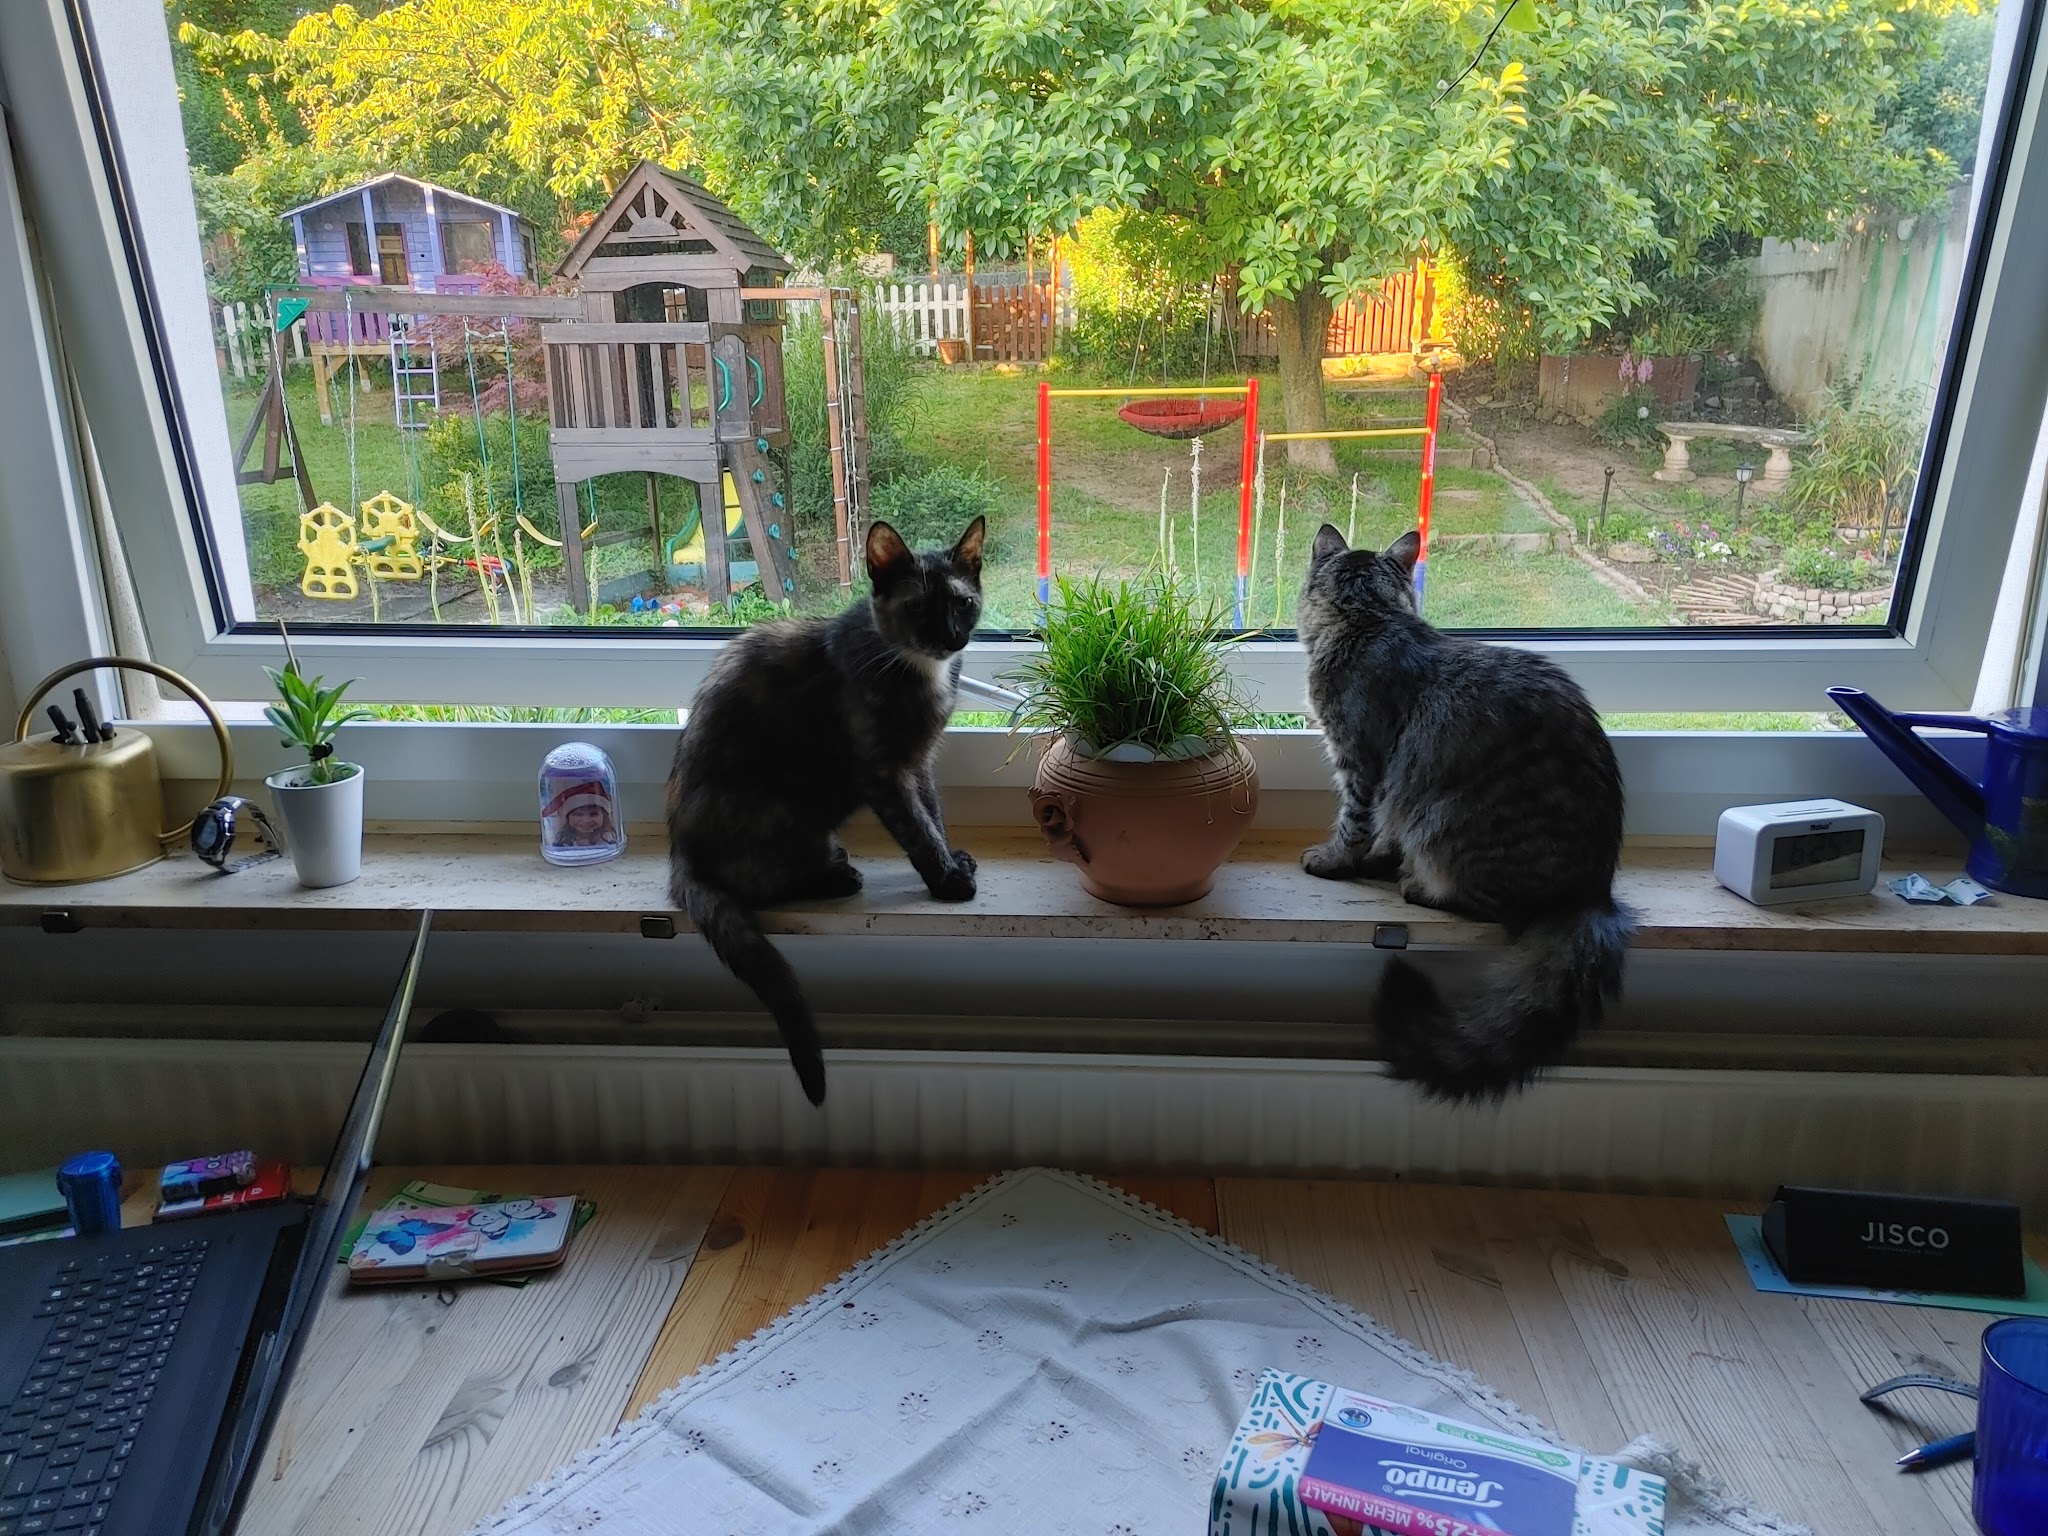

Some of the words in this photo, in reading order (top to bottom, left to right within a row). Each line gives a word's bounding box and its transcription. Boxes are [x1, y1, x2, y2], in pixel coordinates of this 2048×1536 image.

[1860, 1221, 1950, 1249] JISCO
[1405, 1445, 1467, 1469] Original
[1303, 1485, 1361, 1511] INHALT
[1384, 1464, 1504, 1507] Tempo
[1363, 1501, 1411, 1527] MEHR
